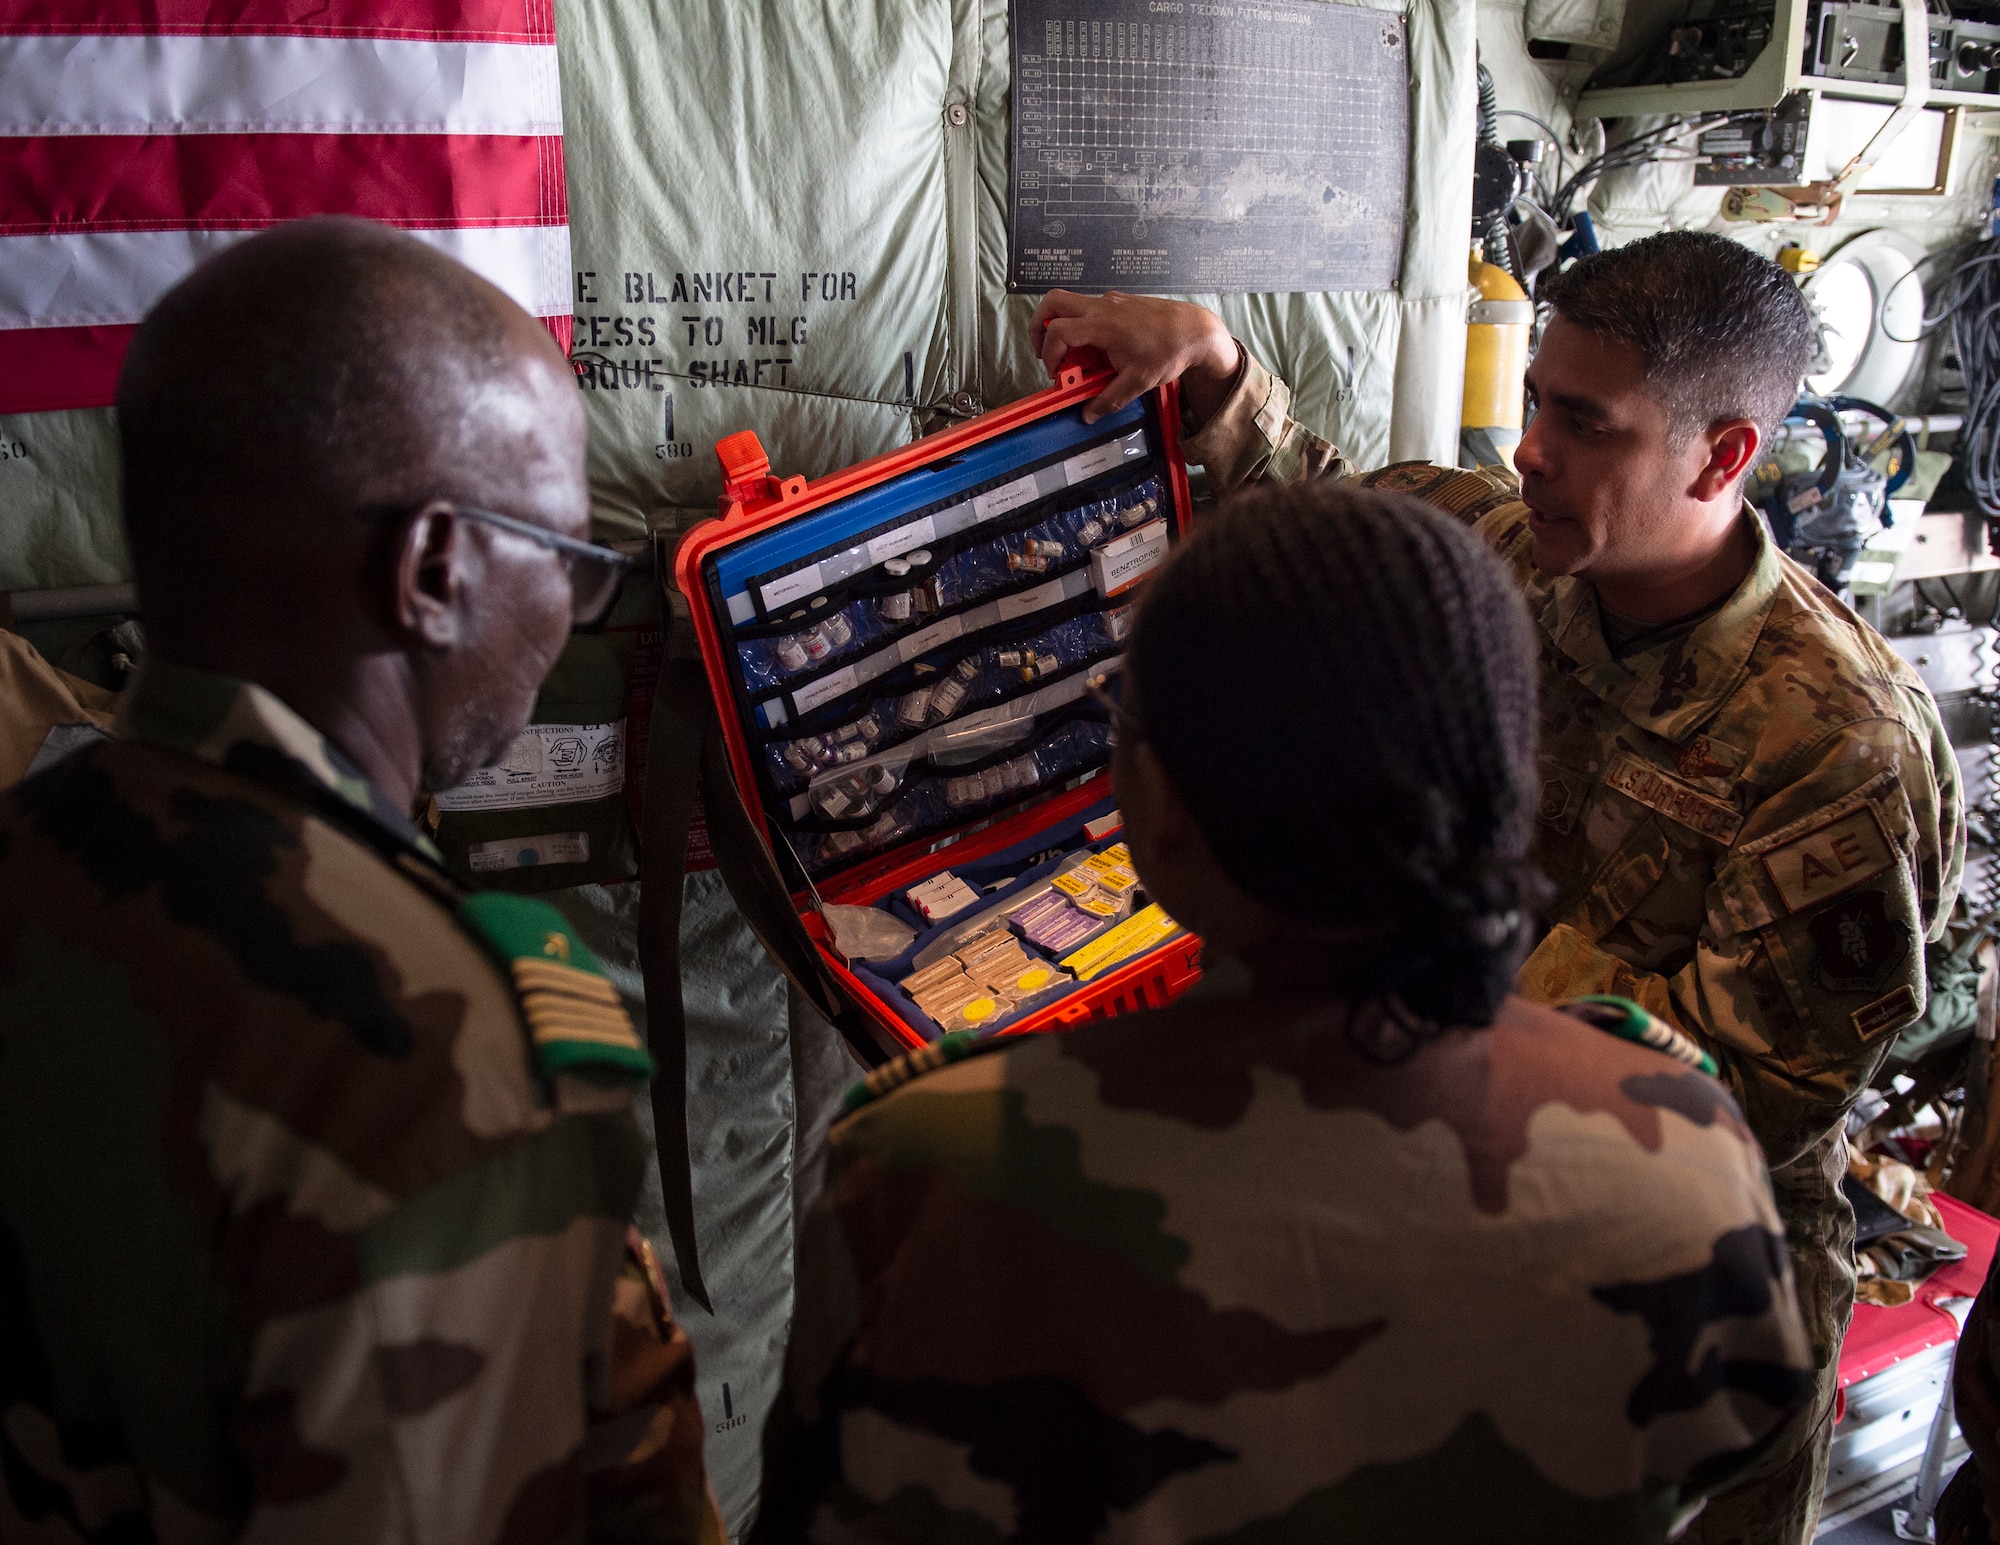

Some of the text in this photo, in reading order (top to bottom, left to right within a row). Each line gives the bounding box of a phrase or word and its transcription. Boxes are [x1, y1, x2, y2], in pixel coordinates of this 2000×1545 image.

[1149, 1, 1184, 14] CARGO
[1236, 7, 1273, 21] FITTING
[1274, 11, 1312, 25] DIAGRAM
[625, 272, 777, 304] BLANKET
[802, 272, 857, 302] FOR
[682, 316, 724, 347] TO
[748, 316, 808, 346] MLG
[688, 359, 793, 389] SHAFT
[655, 443, 693, 460] 580
[1111, 546, 1161, 577] BENZTROPINE
[521, 726, 575, 736] NSTRUCTIONS
[530, 780, 567, 789] CAUTION
[1637, 777, 1673, 812] AIR
[1672, 788, 1737, 839] FORCE
[1801, 831, 1869, 890] AE
[716, 1414, 746, 1434] 580
